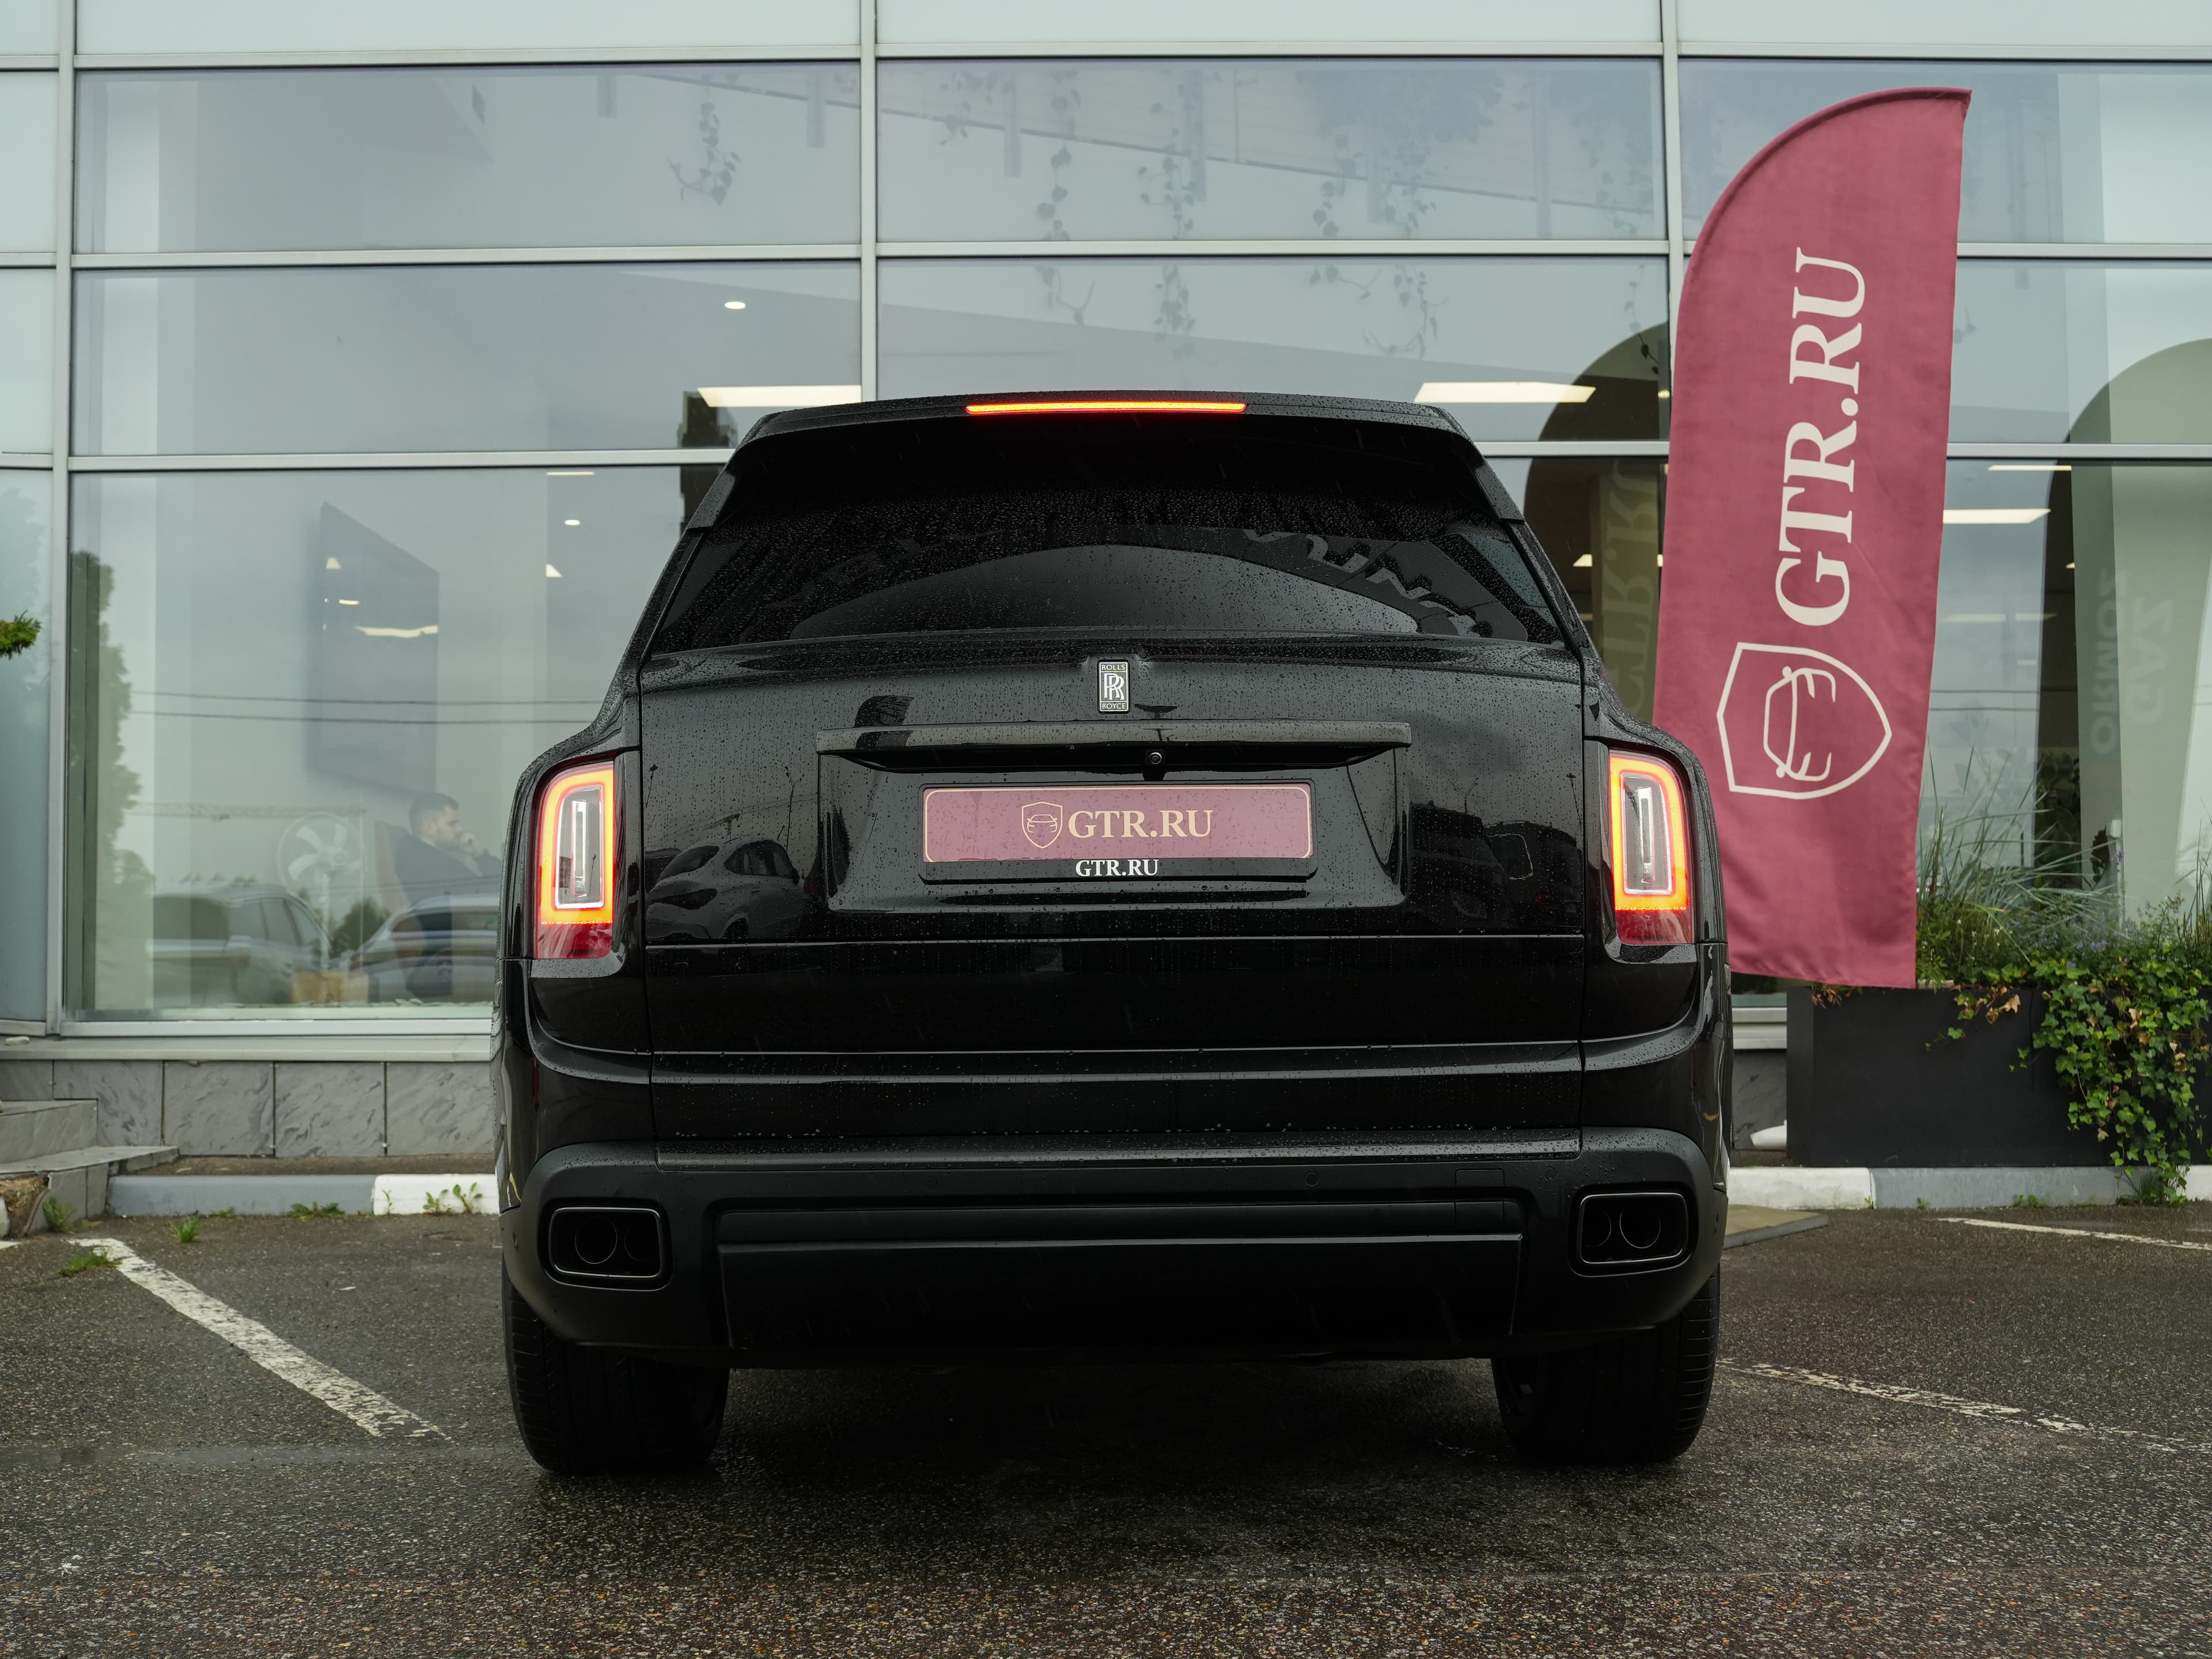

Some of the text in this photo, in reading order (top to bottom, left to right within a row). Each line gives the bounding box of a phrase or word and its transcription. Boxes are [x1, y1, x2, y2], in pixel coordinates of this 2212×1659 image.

[1775, 247, 1865, 626] GTR.RU
[1103, 672, 1125, 700] RR
[1067, 809, 1214, 838] GTR.RU
[1075, 859, 1159, 877] GTR.RU
